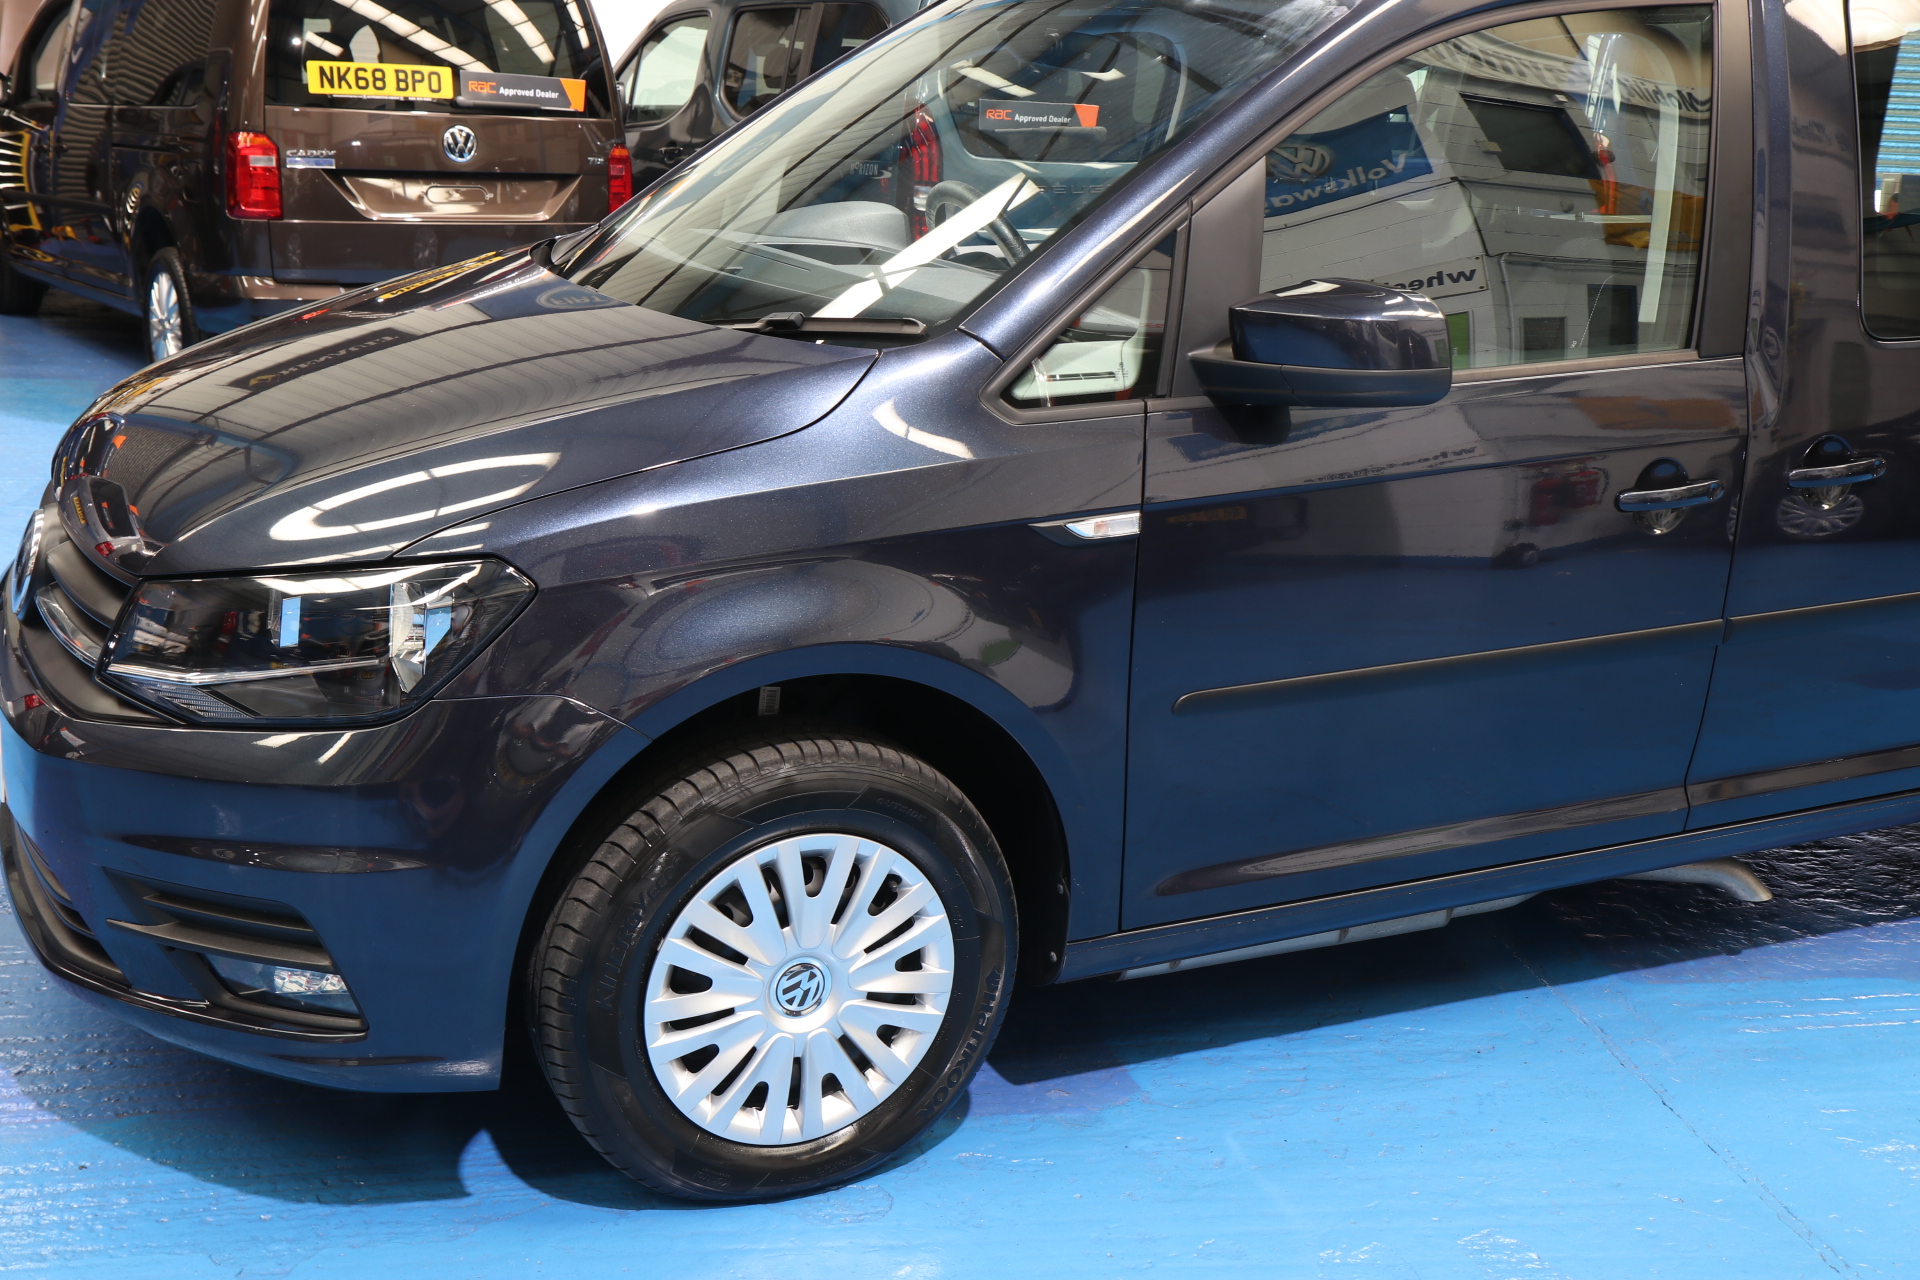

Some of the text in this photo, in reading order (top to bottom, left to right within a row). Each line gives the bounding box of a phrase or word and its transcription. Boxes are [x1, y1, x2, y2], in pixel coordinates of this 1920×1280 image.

[318, 65, 442, 94] NK68 BPO
[499, 86, 534, 97] Approved
[535, 88, 559, 99] Dealer
[1014, 113, 1048, 124] Approved
[1048, 114, 1072, 124] Dealer
